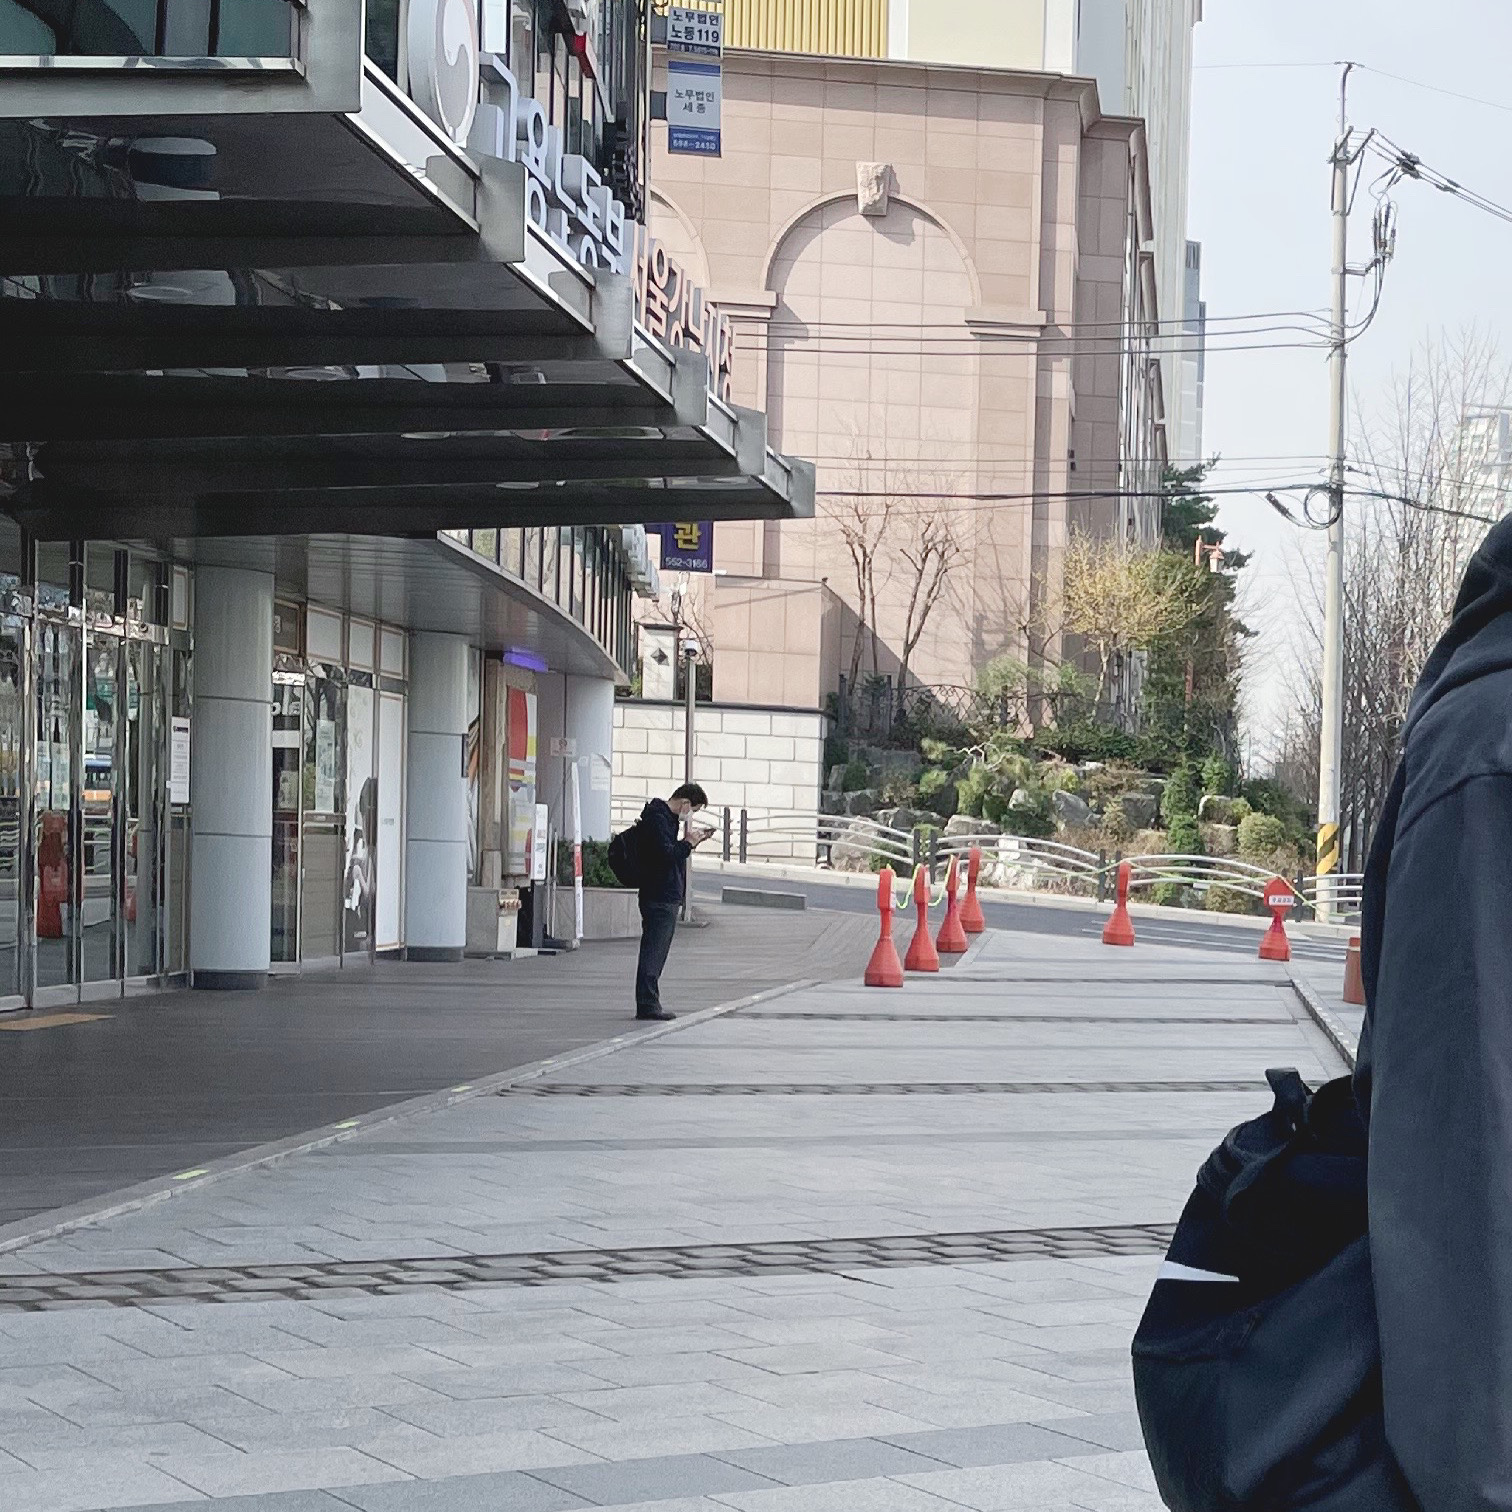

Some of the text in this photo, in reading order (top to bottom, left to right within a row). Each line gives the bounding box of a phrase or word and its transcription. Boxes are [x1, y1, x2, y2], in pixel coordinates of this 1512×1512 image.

[672, 10, 719, 26] 노무법인
[671, 24, 719, 43] 노동119
[674, 89, 715, 103] 노무법인
[673, 522, 703, 550] 관
